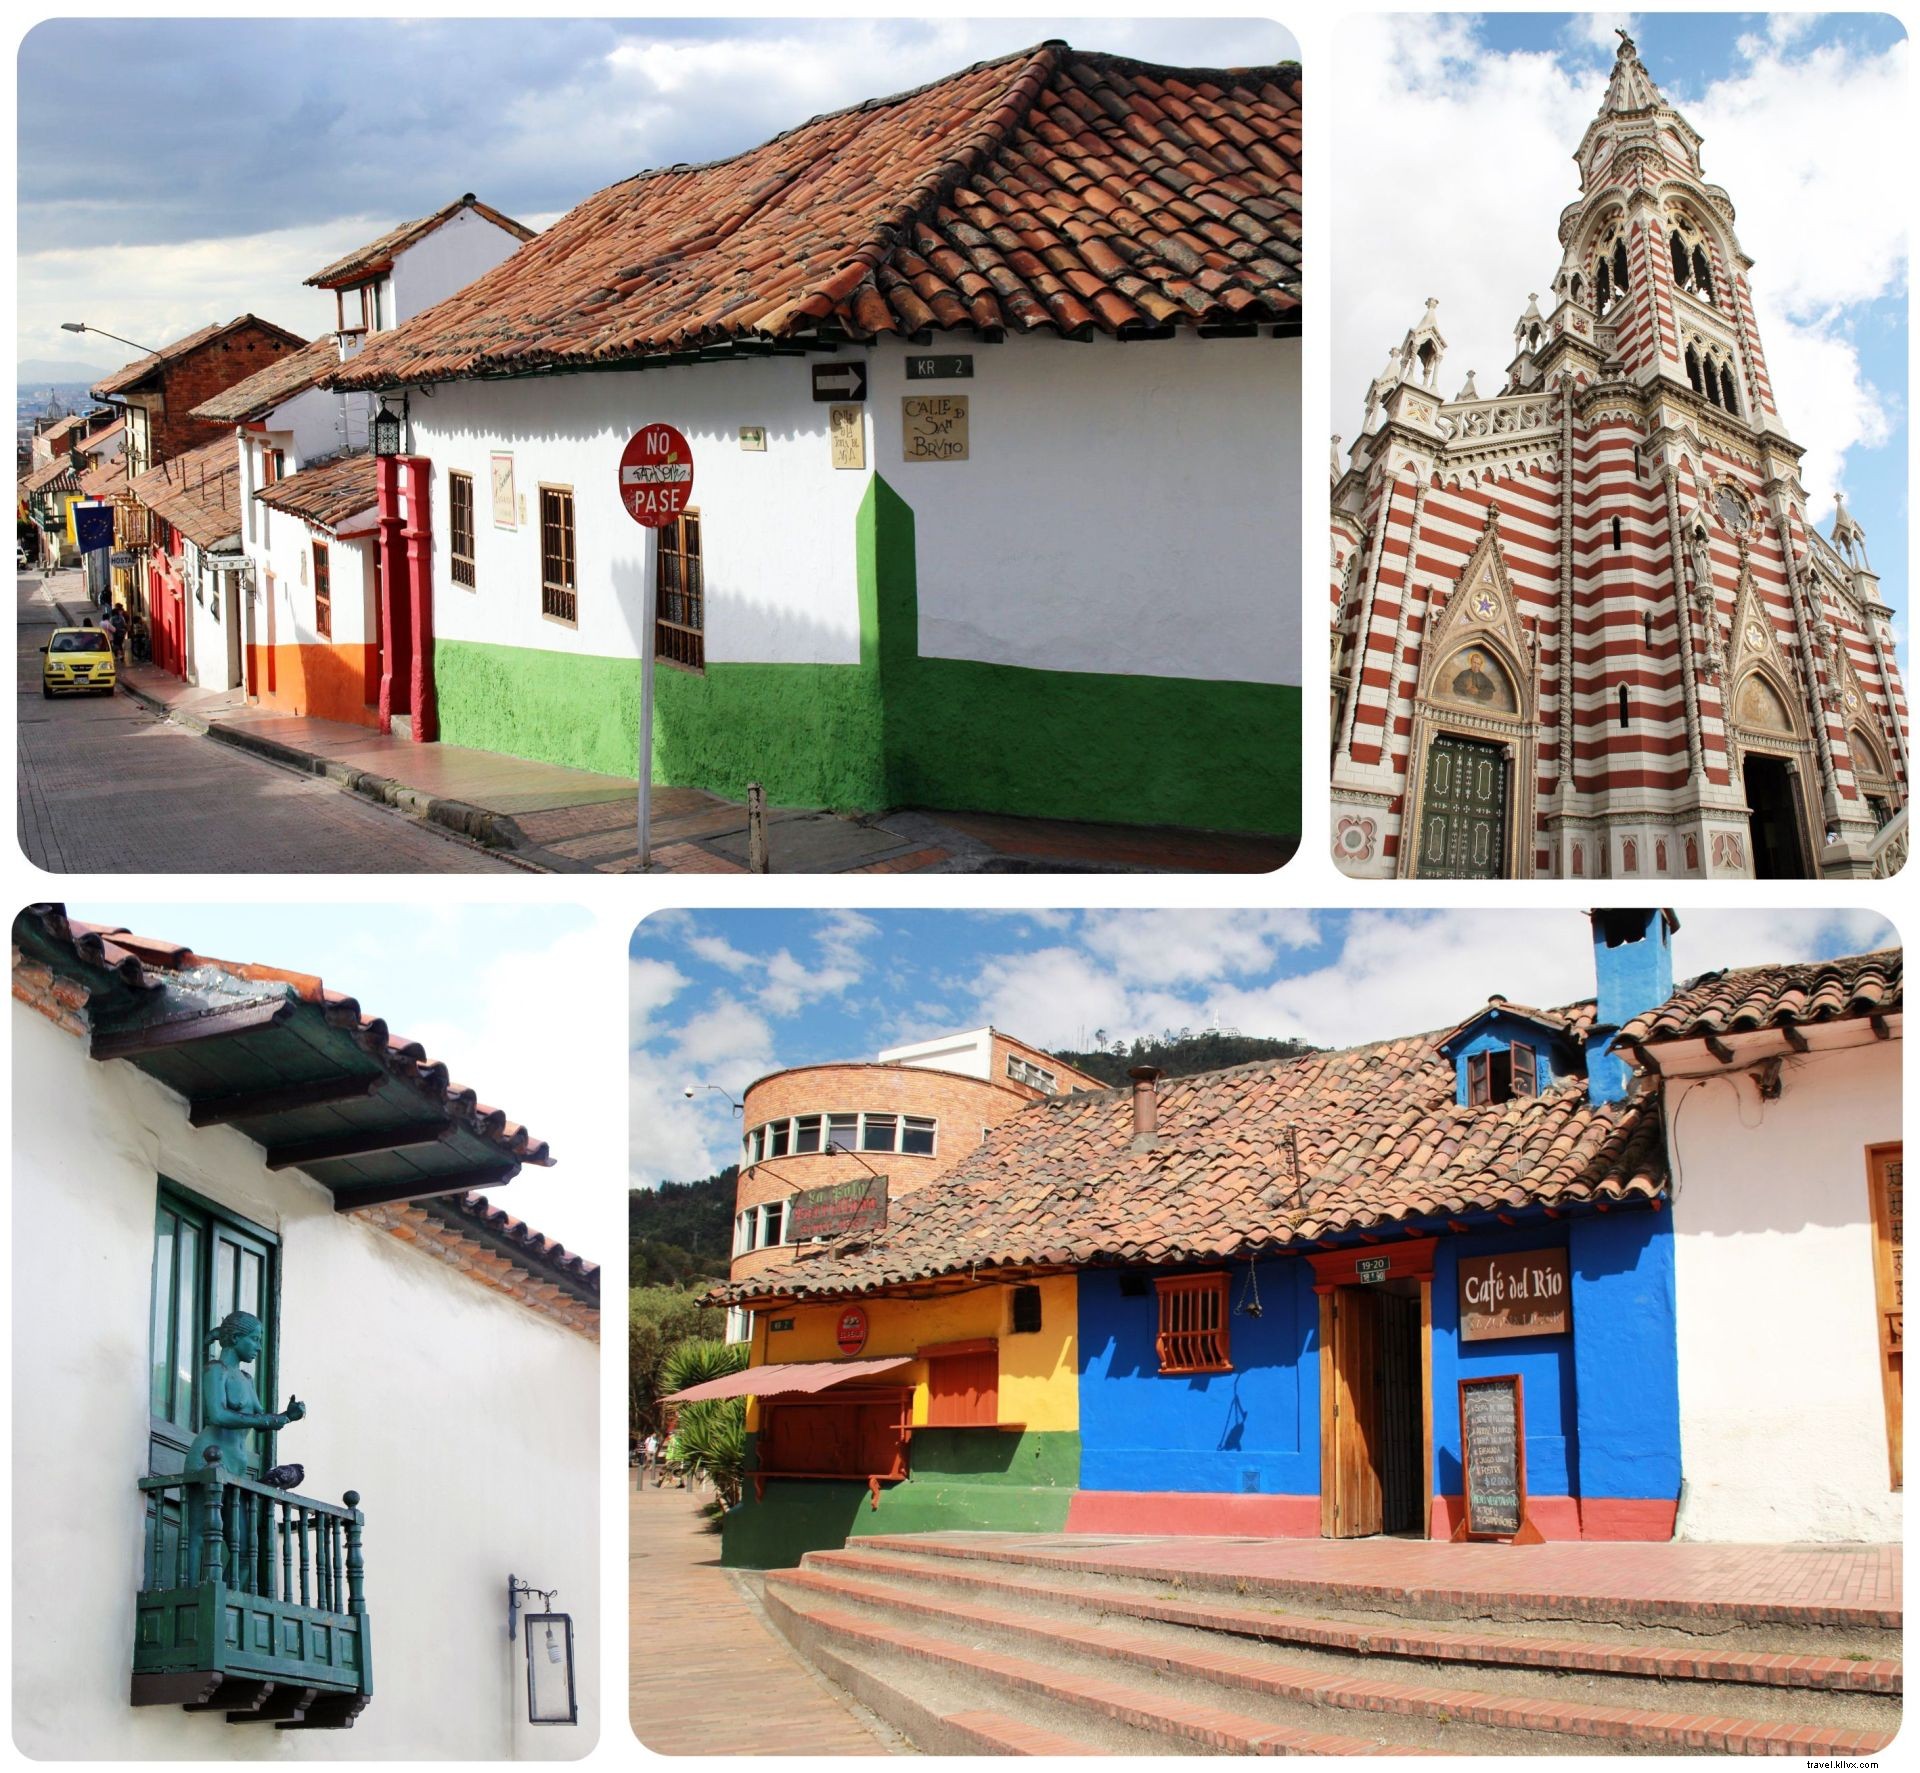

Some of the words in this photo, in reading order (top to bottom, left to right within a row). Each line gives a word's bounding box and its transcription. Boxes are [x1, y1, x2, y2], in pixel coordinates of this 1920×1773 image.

[918, 360, 935, 375] KR
[955, 359, 963, 374] 2
[905, 400, 950, 417] CALLE
[914, 416, 952, 435] SAN
[646, 432, 670, 455] NO
[635, 489, 681, 513] PASE
[1362, 1259, 1384, 1270] 19-20
[1465, 1261, 1504, 1313] Café
[1508, 1267, 1529, 1299] del
[1532, 1267, 1562, 1299] Río
